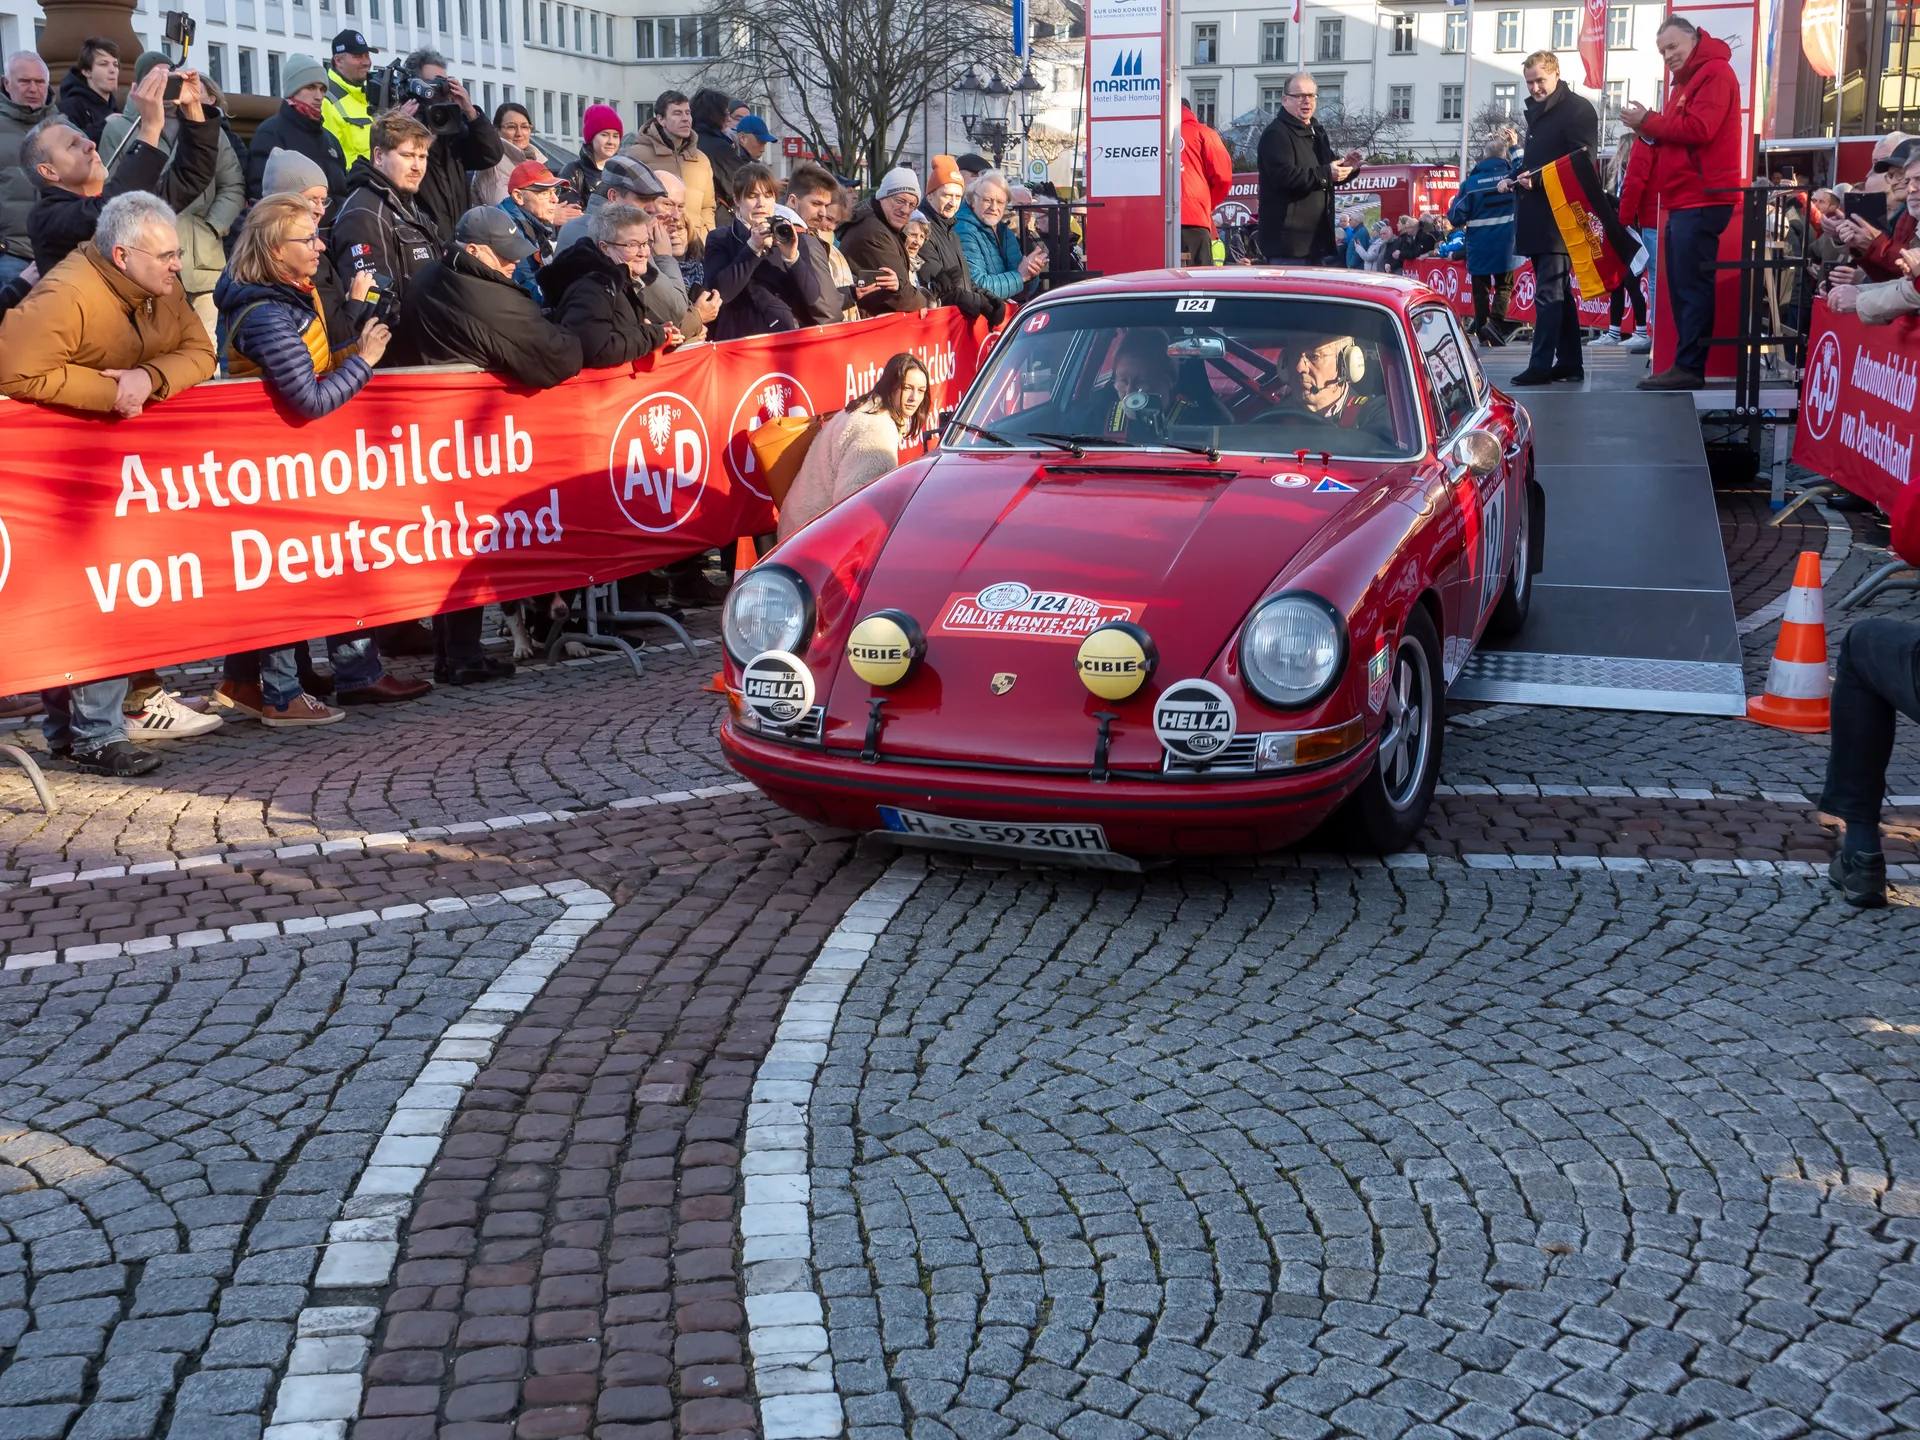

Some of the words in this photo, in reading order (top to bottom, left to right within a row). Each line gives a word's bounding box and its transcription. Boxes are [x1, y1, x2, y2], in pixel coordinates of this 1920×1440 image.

[1093, 78, 1160, 93] MARITIM
[1093, 94, 1112, 102] Hotel
[1113, 94, 1126, 102] Bad
[1128, 93, 1160, 102] Homburg
[1104, 146, 1158, 158] SENGER
[1182, 300, 1208, 311] 124
[1028, 314, 1046, 332] H
[1851, 344, 1917, 413] Automobilclub
[639, 414, 647, 426] 18
[672, 408, 682, 420] 99
[1840, 411, 1857, 449] von
[1856, 410, 1914, 485] Deutschland
[115, 414, 534, 517] Automobilclub
[86, 553, 204, 613] von
[231, 488, 563, 592] Deutschland
[949, 604, 1004, 625] RALLYE
[1030, 595, 1066, 612] 124
[1070, 598, 1099, 617] 2025
[748, 681, 804, 698] HELLA
[1161, 712, 1228, 730] HELLA
[901, 814, 930, 834] H
[950, 823, 976, 840] S
